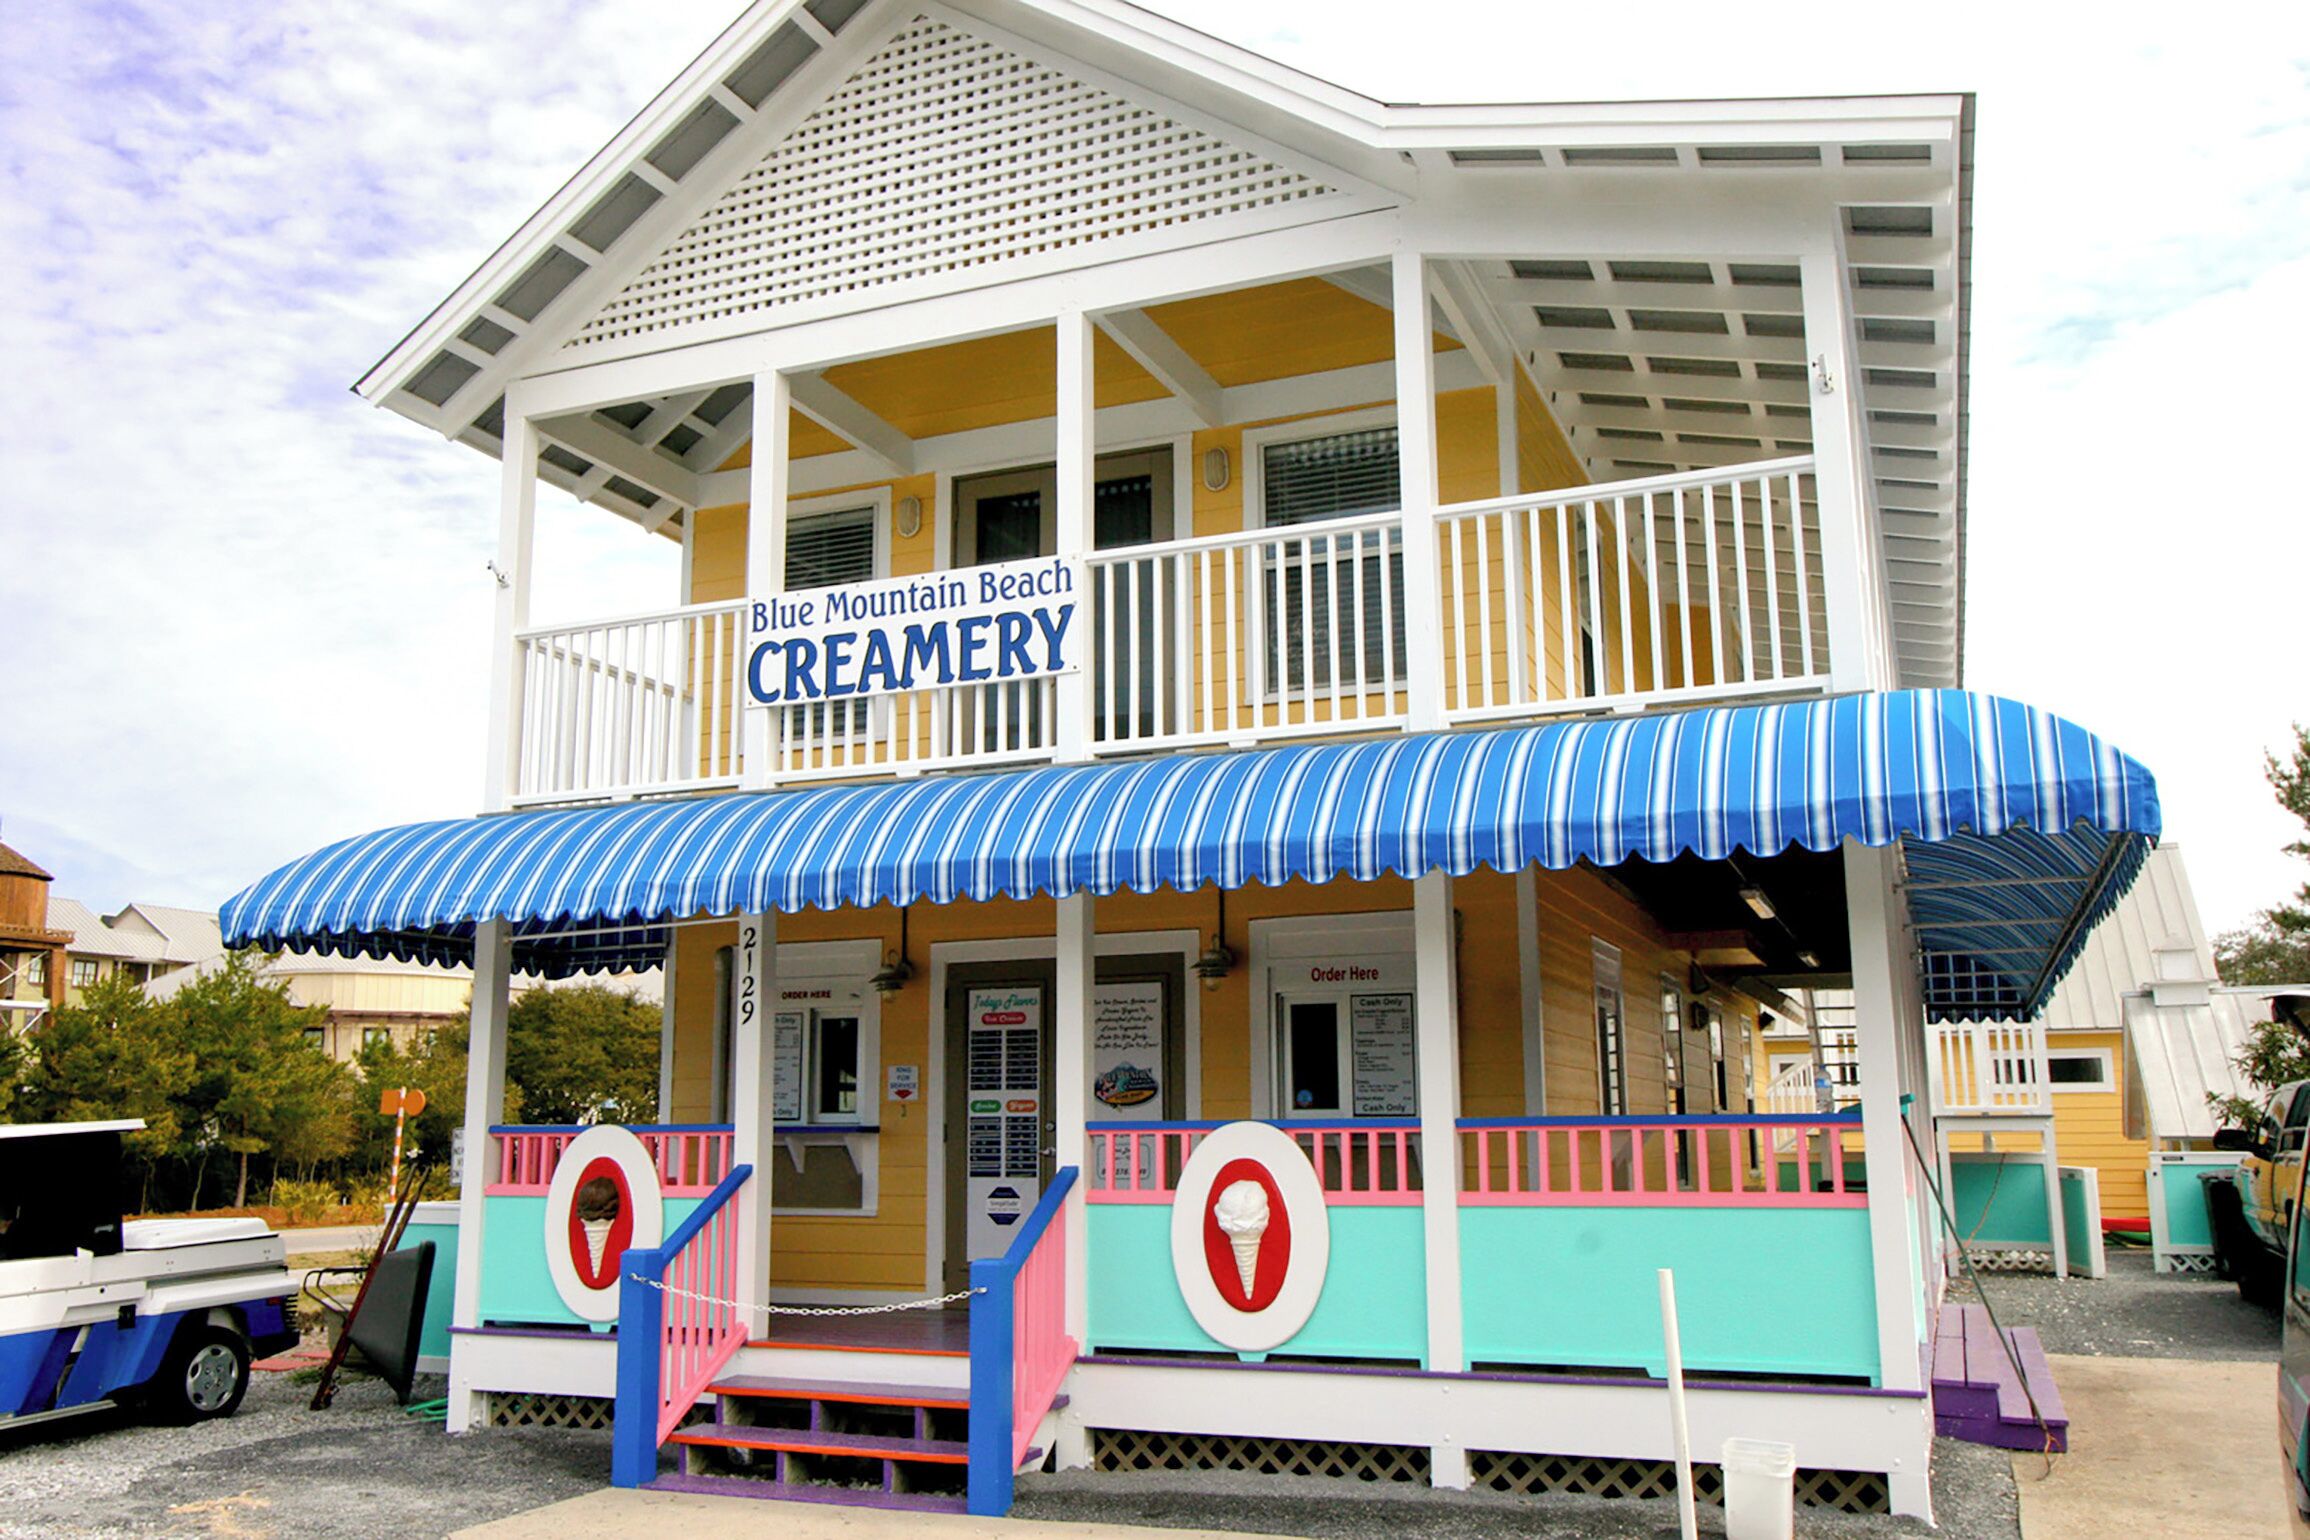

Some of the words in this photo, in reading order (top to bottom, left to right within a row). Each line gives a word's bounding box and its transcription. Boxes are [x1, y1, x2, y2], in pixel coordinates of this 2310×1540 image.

[752, 598, 814, 633] Blue
[824, 575, 967, 624] Mountain
[979, 559, 1073, 604] Beach
[748, 603, 1076, 704] CREAMERY
[741, 927, 757, 1026] 2129
[1311, 966, 1346, 982] Order
[1350, 965, 1379, 981] Here
[782, 991, 808, 1000] ORDER
[810, 990, 831, 999] HERE
[1360, 998, 1381, 1007] Cash
[1383, 997, 1403, 1007] Only
[1362, 1103, 1384, 1112] Cash
[1386, 1102, 1406, 1113] Only
